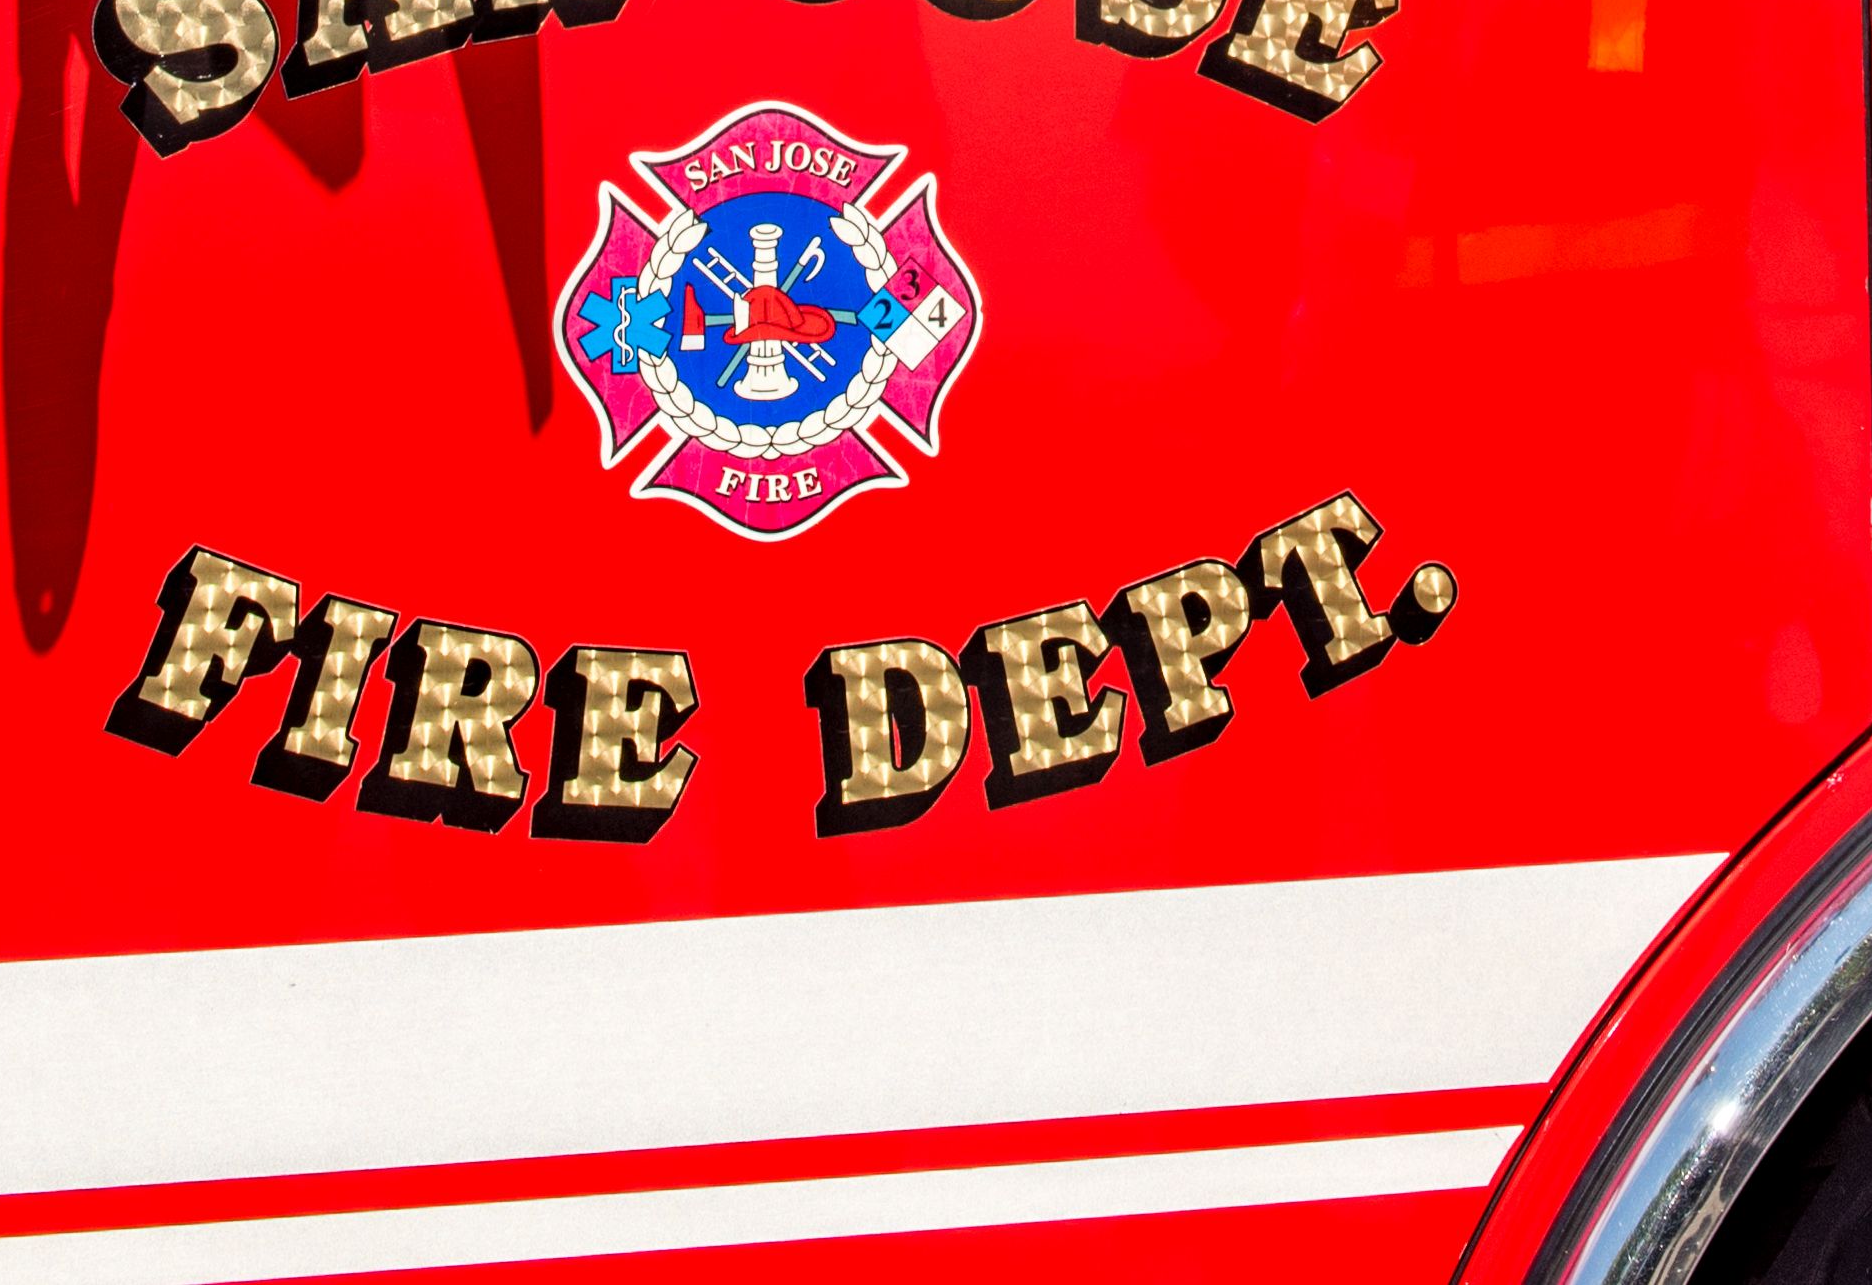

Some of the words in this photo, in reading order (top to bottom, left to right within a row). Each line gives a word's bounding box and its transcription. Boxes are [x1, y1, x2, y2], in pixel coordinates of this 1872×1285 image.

[684, 141, 757, 192] SAN
[763, 139, 858, 189] JOSE
[900, 268, 921, 302] 3
[871, 298, 896, 330] 2
[927, 295, 947, 328] 4
[715, 466, 823, 503] FIRE
[105, 544, 700, 844] FIRE
[804, 490, 1459, 839] DEPT.
